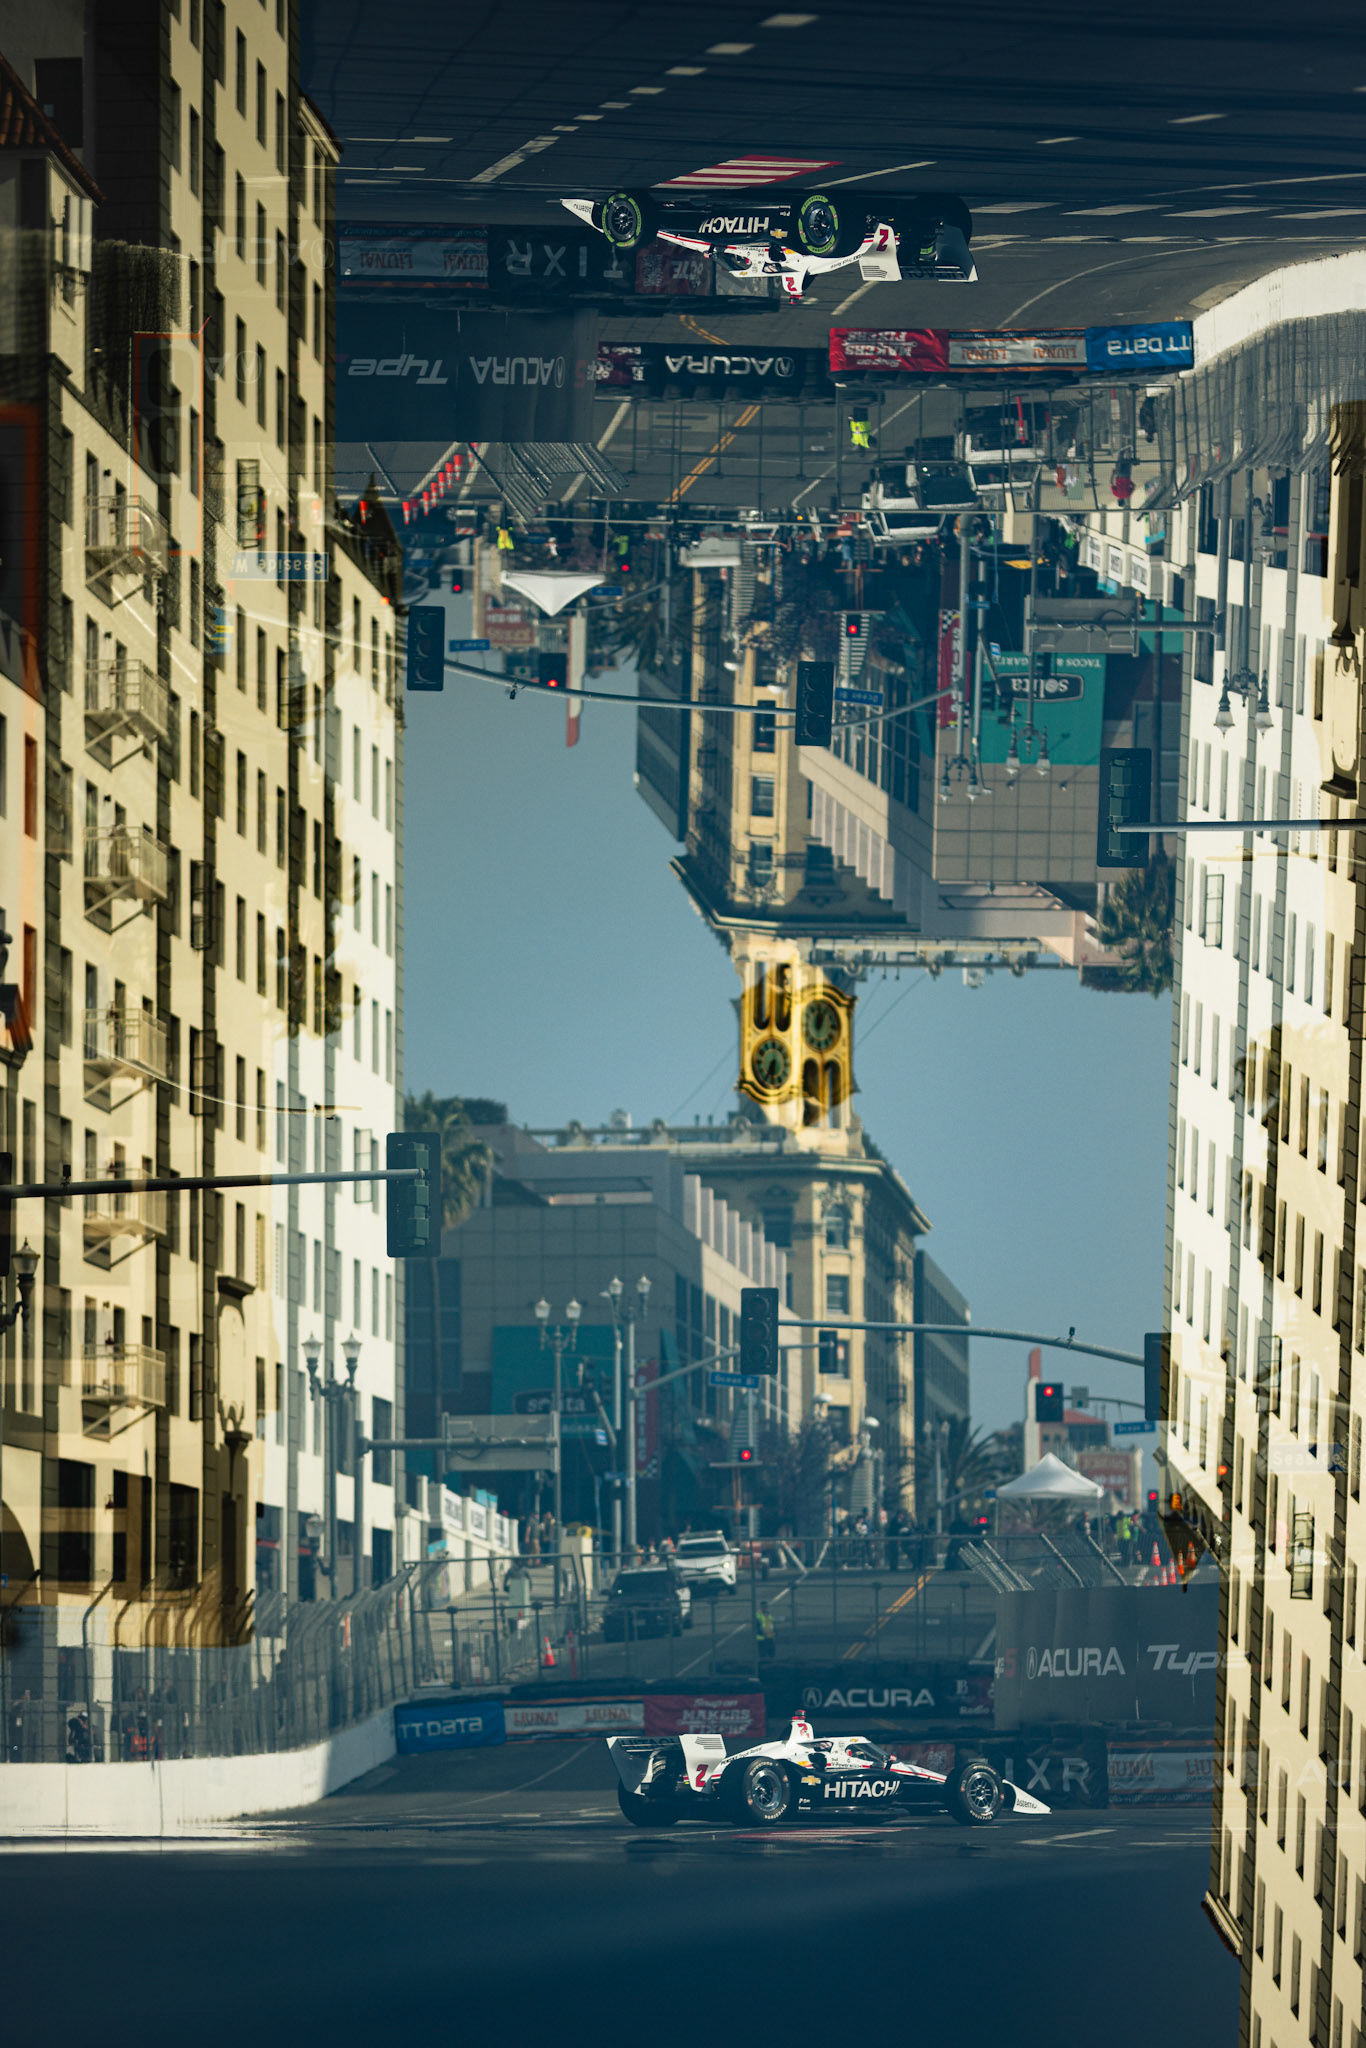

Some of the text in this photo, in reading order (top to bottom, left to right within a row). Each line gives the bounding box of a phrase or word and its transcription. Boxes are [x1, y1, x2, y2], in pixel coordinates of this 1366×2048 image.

[698, 216, 770, 233] HITACHI
[876, 229, 889, 251] 2
[785, 277, 797, 292] 2
[469, 356, 555, 385] ACURA
[665, 355, 774, 376] ACURA
[257, 559, 324, 574] Seaside
[1066, 658, 1101, 668] TACOS
[1037, 1647, 1126, 1677] ACURA
[823, 1688, 936, 1708] ACURA
[682, 1709, 751, 1720] MAKERS
[695, 1764, 709, 1787] 2
[824, 1781, 901, 1798] HITACHI
